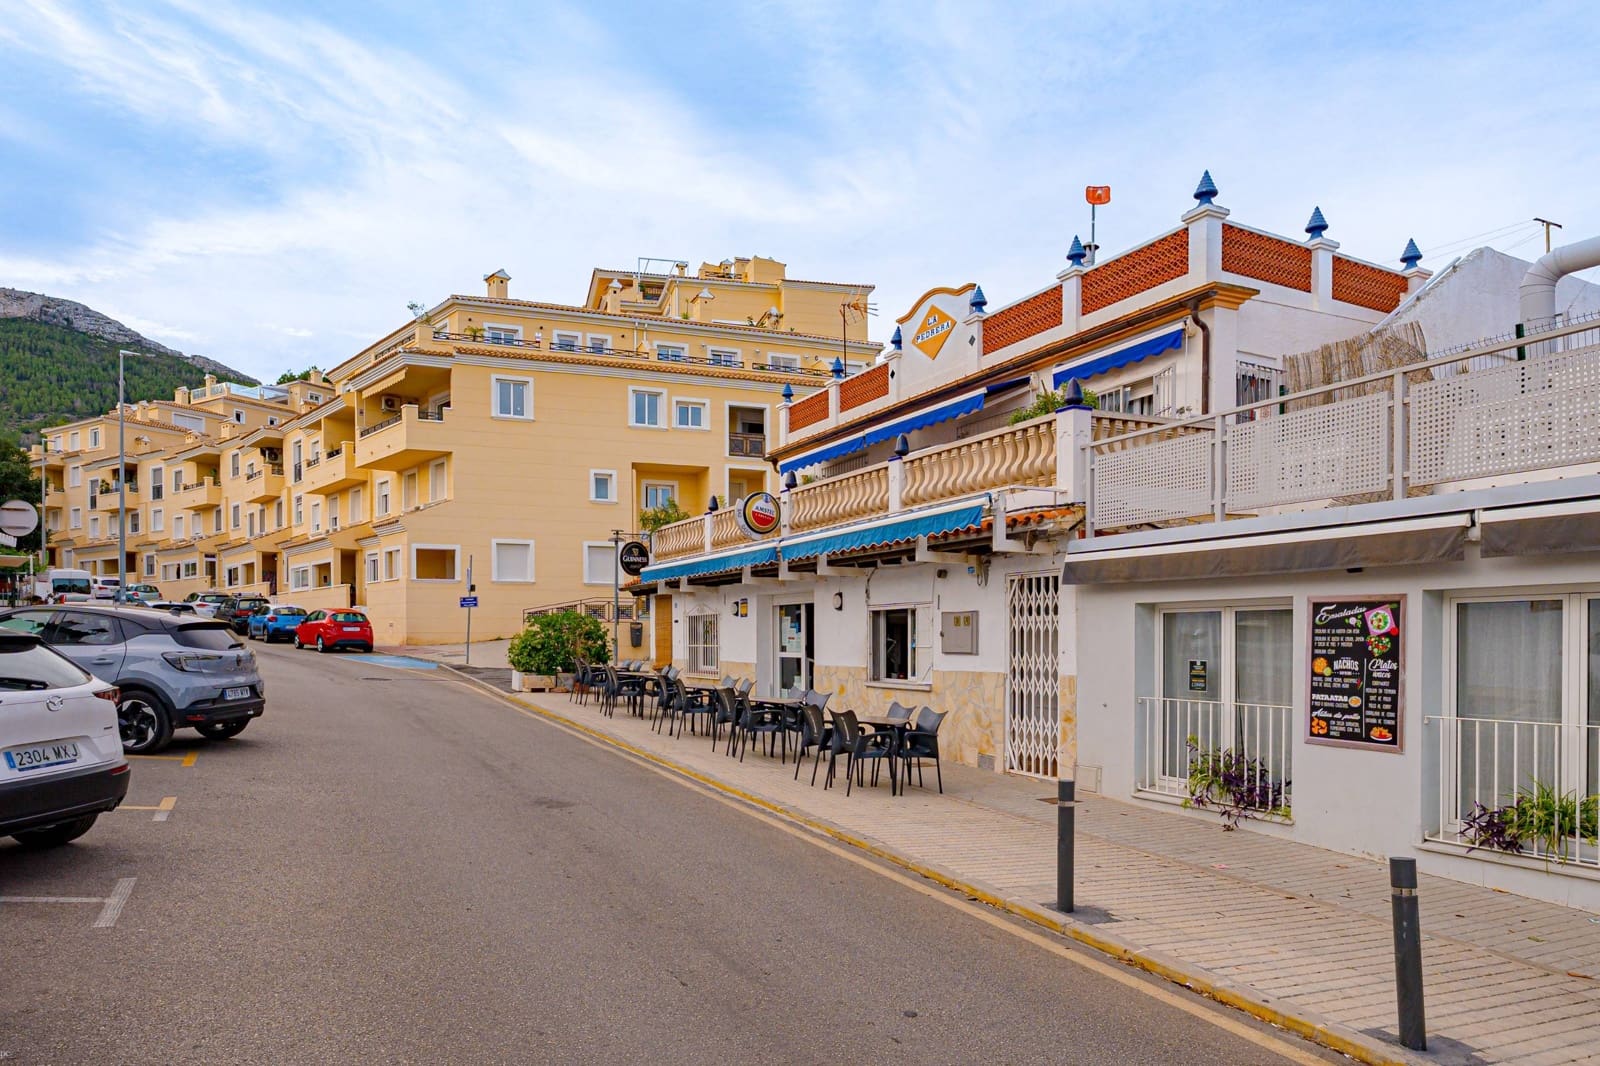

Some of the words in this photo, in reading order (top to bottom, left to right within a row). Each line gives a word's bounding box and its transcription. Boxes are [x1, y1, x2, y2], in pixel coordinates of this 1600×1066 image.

[927, 315, 938, 326] LA
[916, 321, 950, 342] PEDRERA
[1333, 659, 1359, 671] NACHOS
[16, 748, 50, 767] 2304
[52, 743, 78, 760] MXJ
